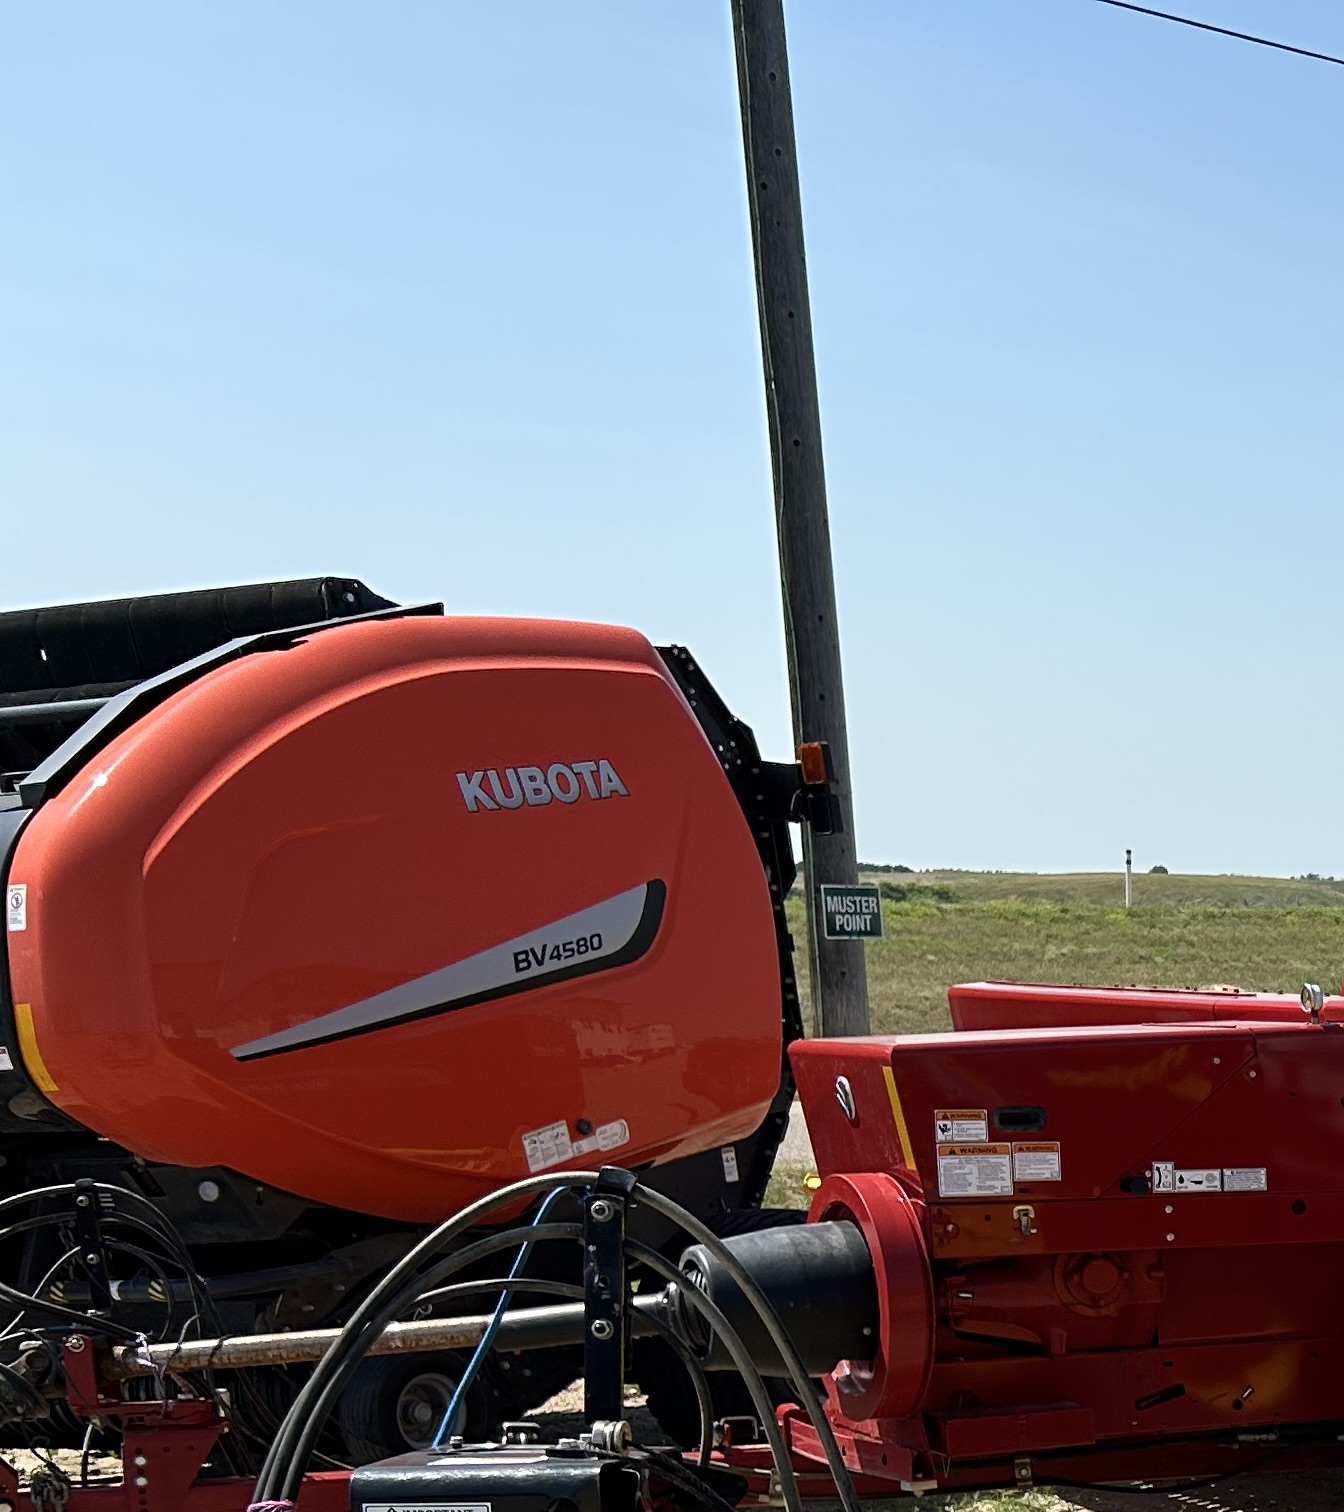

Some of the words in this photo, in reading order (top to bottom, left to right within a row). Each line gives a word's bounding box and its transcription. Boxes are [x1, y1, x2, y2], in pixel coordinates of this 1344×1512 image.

[456, 759, 631, 813] KUBOTA
[826, 895, 878, 913] MUSTER
[835, 914, 872, 931] POINT
[512, 933, 603, 973] BV4580
